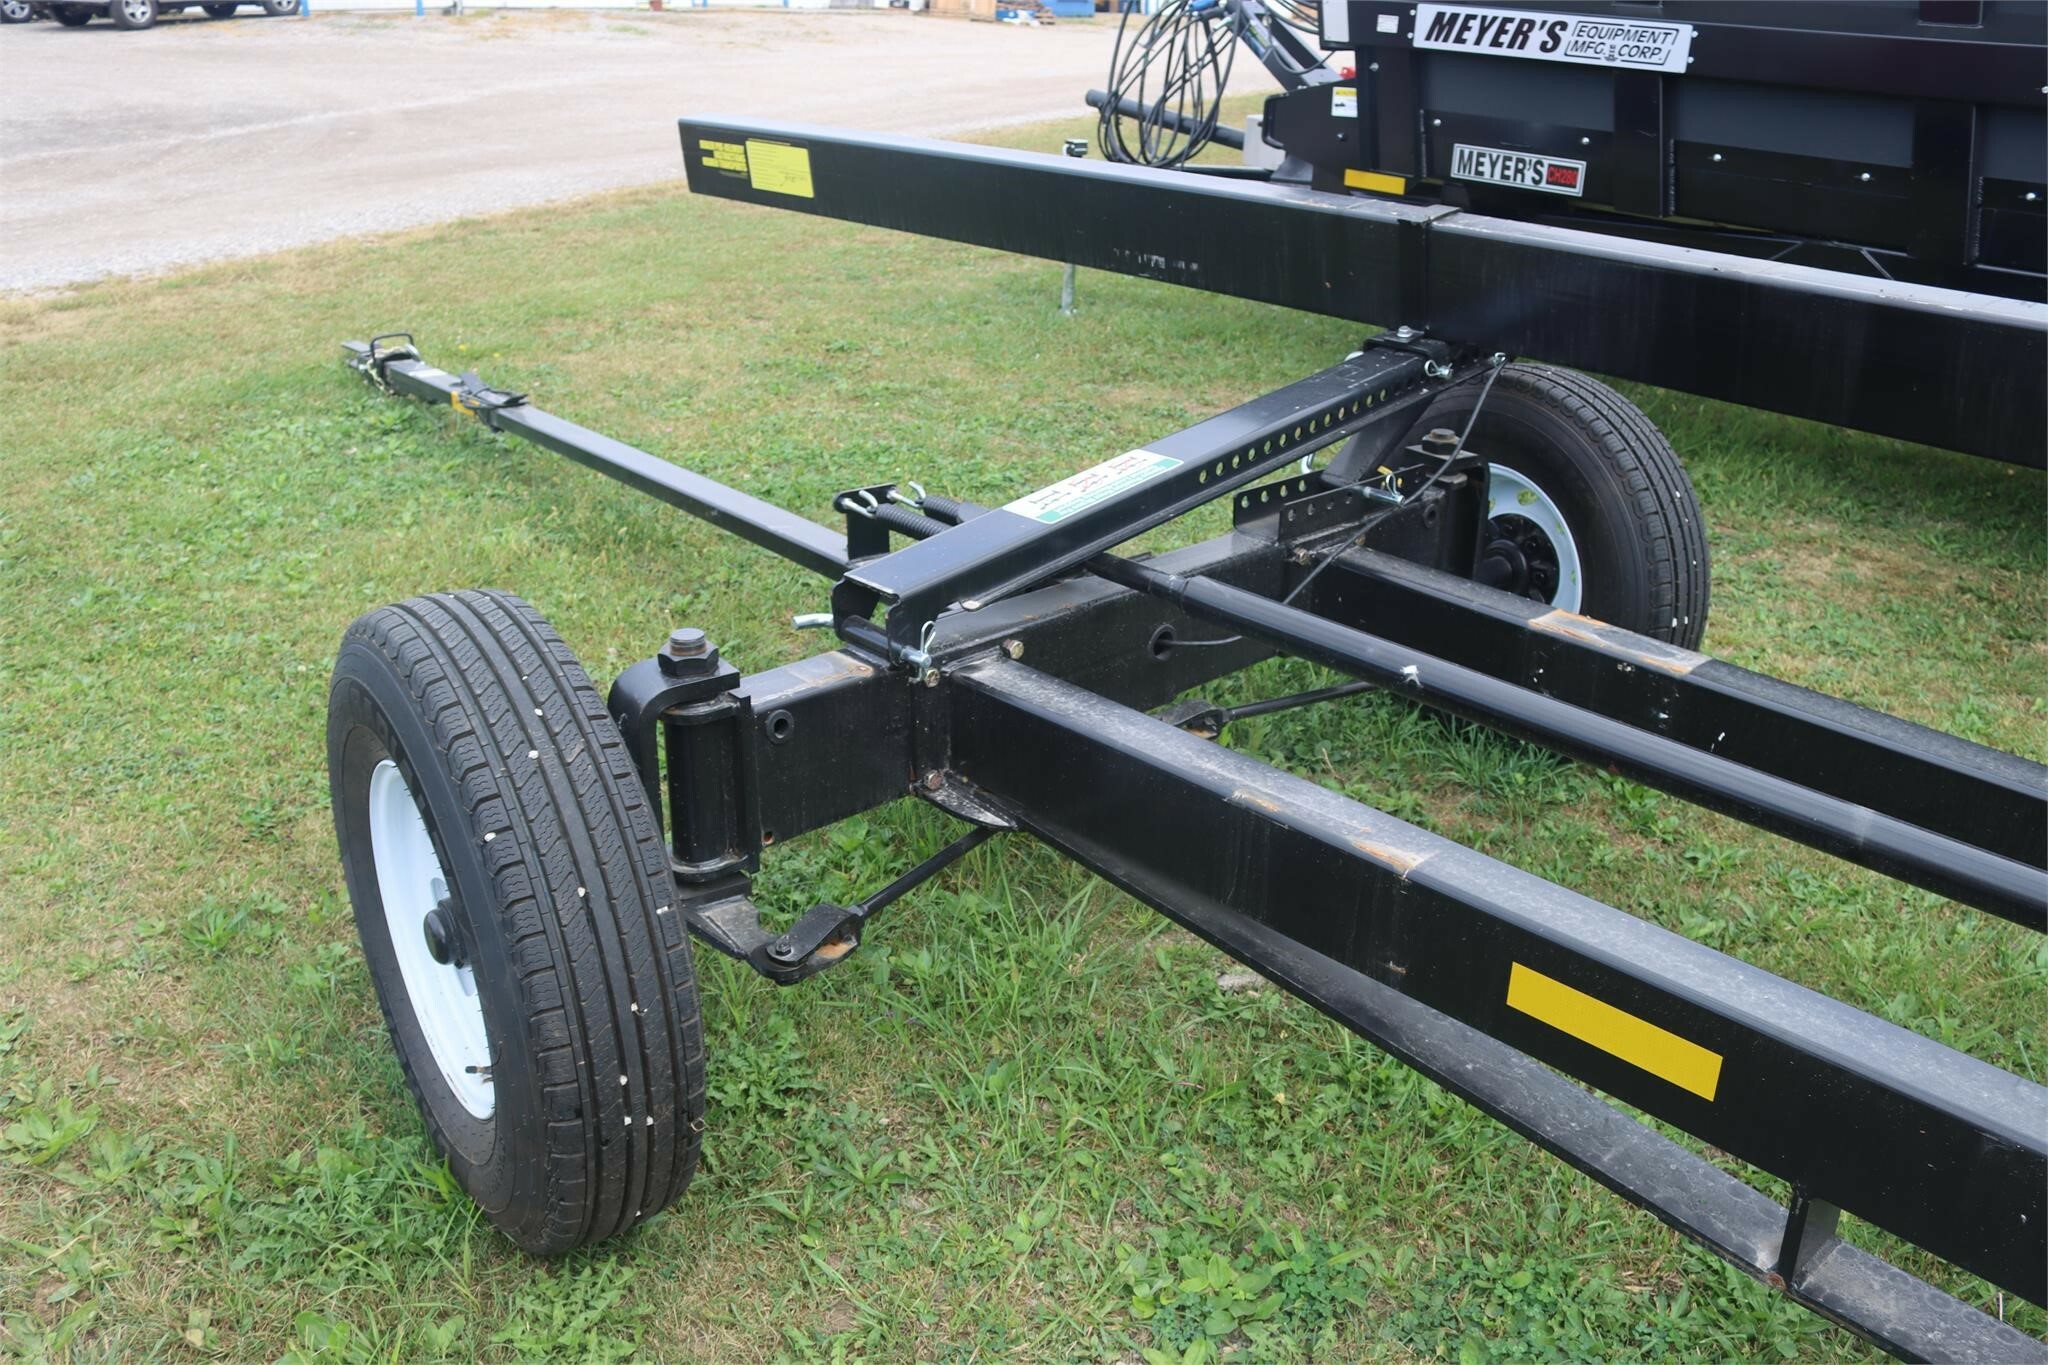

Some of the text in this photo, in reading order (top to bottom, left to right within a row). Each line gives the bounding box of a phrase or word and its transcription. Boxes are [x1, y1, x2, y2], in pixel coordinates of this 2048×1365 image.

[1424, 11, 1568, 54] MEYER'S
[1576, 24, 1673, 45] EQUIPMENT
[1570, 40, 1663, 61] MFG. CORP.
[1457, 149, 1545, 186] MEYER'S
